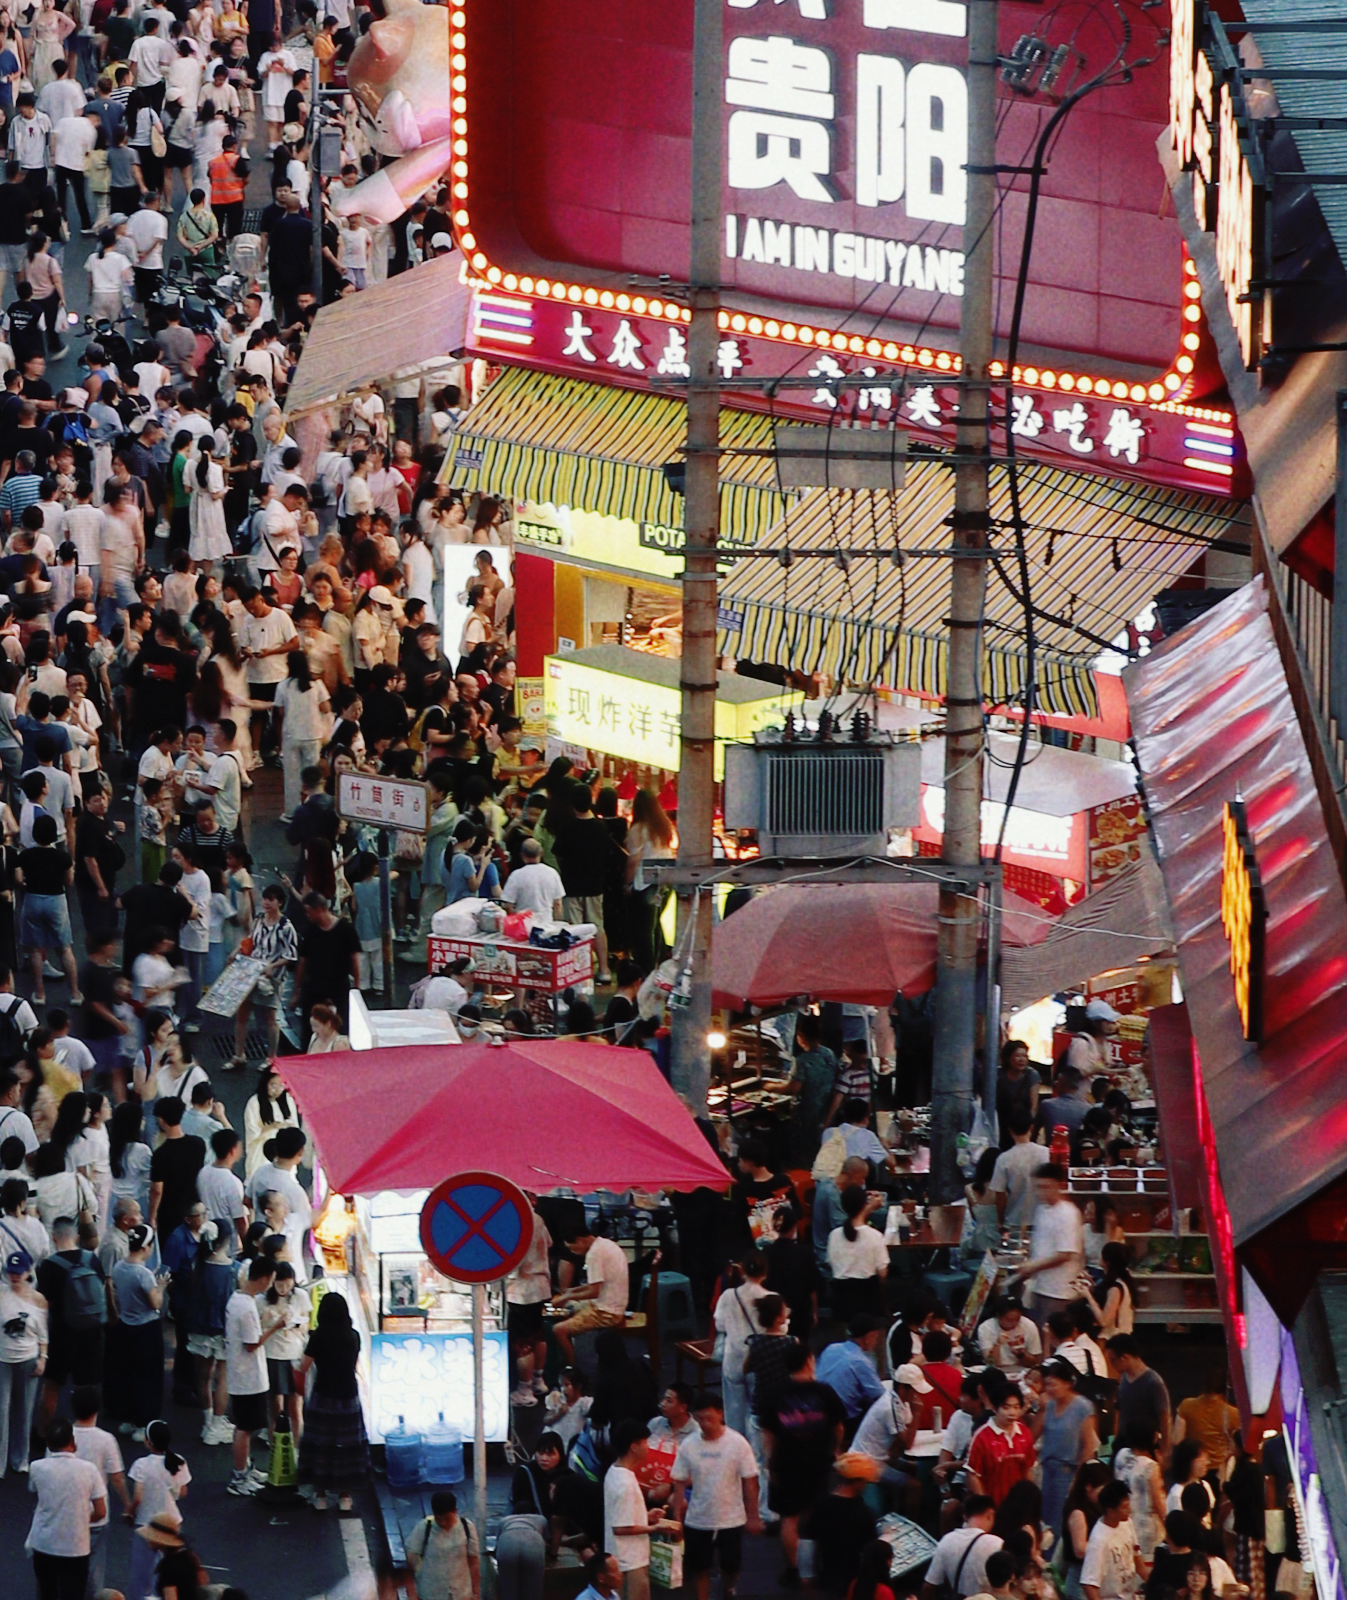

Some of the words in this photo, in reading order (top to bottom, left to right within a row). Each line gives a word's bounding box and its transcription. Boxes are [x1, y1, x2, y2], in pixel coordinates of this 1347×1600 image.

[727, 35, 968, 226] 贵阳
[726, 214, 737, 259] I
[742, 217, 791, 268] AM
[794, 226, 829, 274] IN
[644, 523, 686, 550] POTA
[350, 782, 404, 808] 竹筒街
